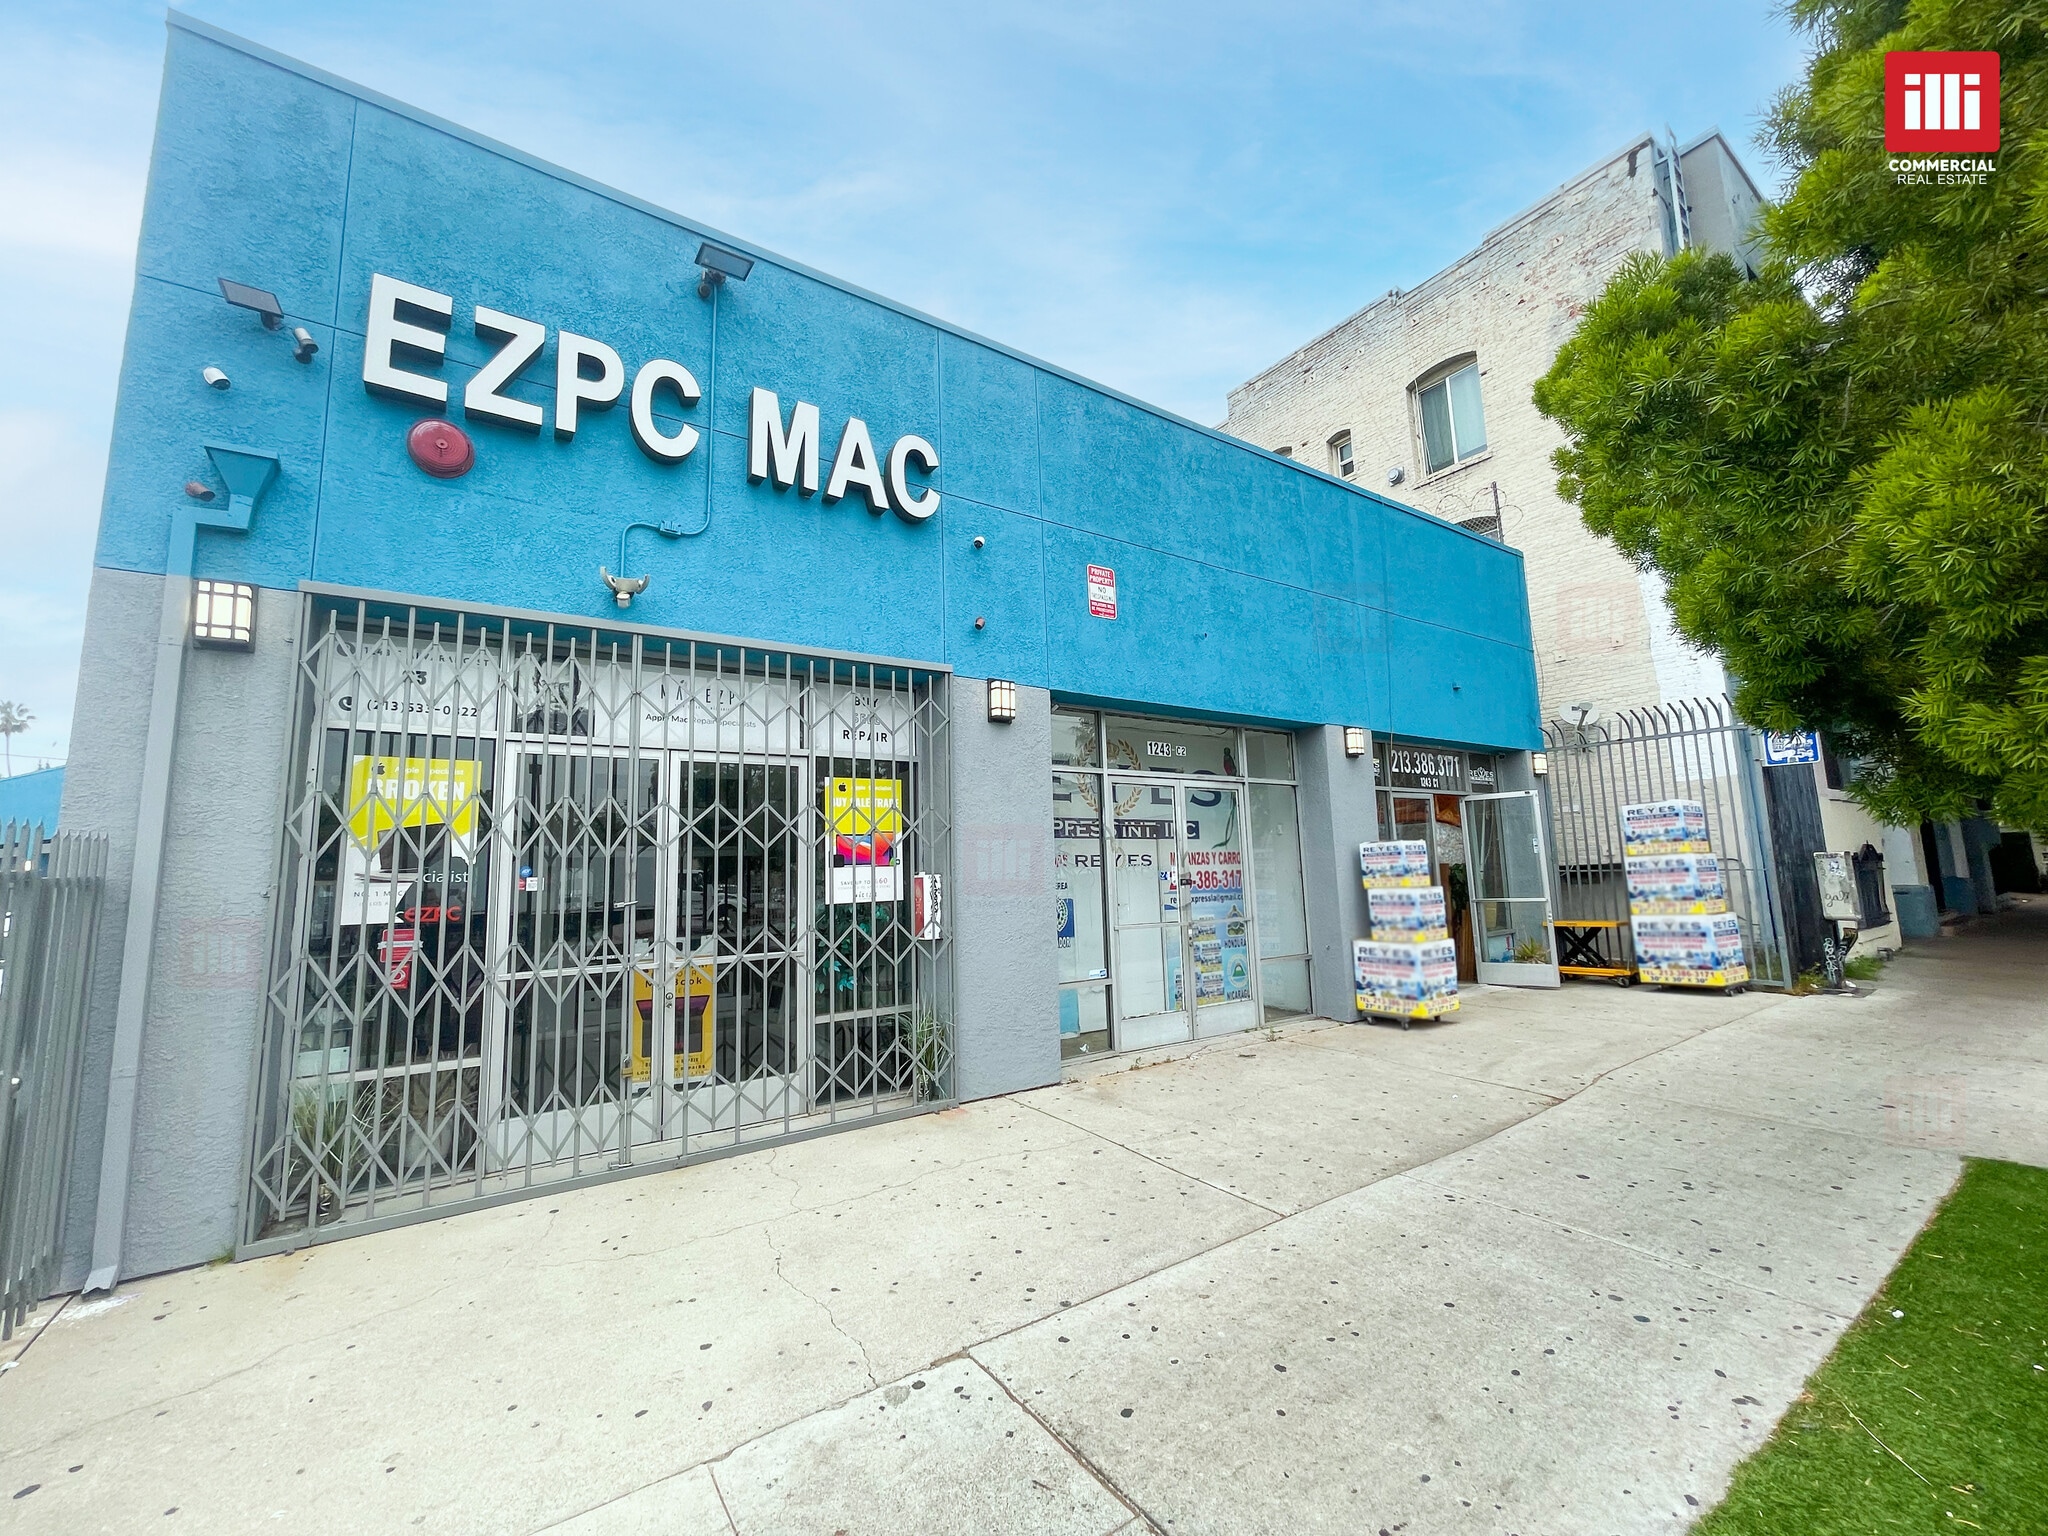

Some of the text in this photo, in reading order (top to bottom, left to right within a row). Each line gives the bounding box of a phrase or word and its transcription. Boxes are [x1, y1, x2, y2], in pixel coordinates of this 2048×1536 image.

[363, 272, 940, 523] EZPC MAC
[671, 715, 689, 723] Mac
[843, 729, 888, 743] RPAIR
[1148, 742, 1186, 756] 1243 C2
[1391, 749, 1460, 778] 213.386.3171
[394, 766, 420, 775] Aple
[1420, 777, 1432, 788] 1243
[367, 779, 465, 801] BROKEN
[1627, 805, 1676, 816] REYES
[1053, 818, 1118, 839] PRES
[1075, 854, 1153, 868] REYES
[1212, 852, 1217, 865] Y
[1628, 859, 1685, 869] REYES
[1419, 892, 1441, 900] REYES
[1638, 922, 1702, 930] REYES
[1712, 919, 1736, 929] REYES
[1358, 946, 1411, 957] REYES
[1421, 946, 1453, 957] REYES
[645, 977, 702, 988] MBook
